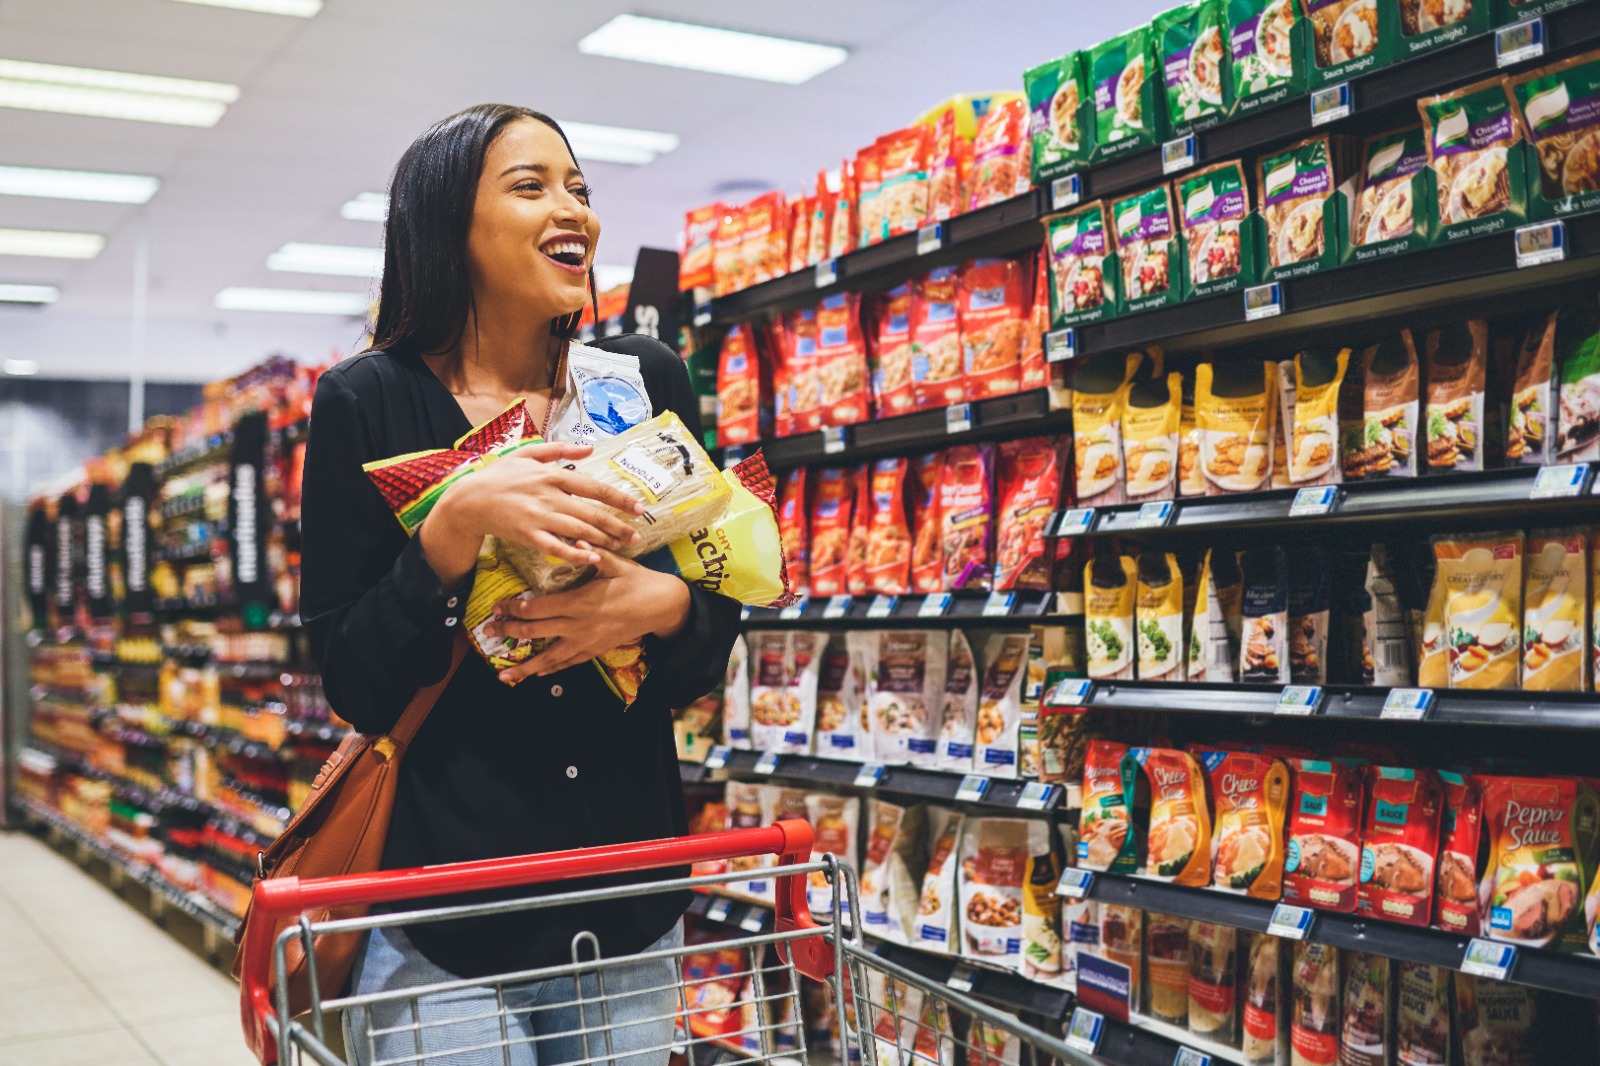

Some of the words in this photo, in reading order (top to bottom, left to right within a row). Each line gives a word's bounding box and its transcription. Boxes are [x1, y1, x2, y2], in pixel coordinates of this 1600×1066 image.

[1409, 38, 1432, 52] Sauce
[1433, 25, 1468, 47] tonight?
[1323, 66, 1344, 80] Sauce
[1344, 55, 1375, 74] tonight?
[1240, 99, 1259, 111] Sauce
[1260, 88, 1288, 105] tonight?
[1299, 176, 1321, 185] Cheese
[1447, 229, 1470, 240] Sauce
[1471, 219, 1505, 236] tonight?
[1356, 250, 1377, 261] Sauce
[1378, 241, 1409, 256] tonight?
[1273, 268, 1292, 280] Sauce
[1293, 261, 1320, 277] tonight?
[1195, 287, 1212, 296] Sauce
[619, 457, 661, 490] NOODLES
[715, 528, 732, 552] CHY
[688, 527, 730, 591] achip
[1154, 767, 1187, 787] Cheese
[1221, 773, 1258, 795] Cheese
[1229, 794, 1258, 815] Sauce
[1380, 808, 1403, 820] SAUCE
[1504, 800, 1566, 828] Pepper
[1507, 825, 1562, 851] Sauce
